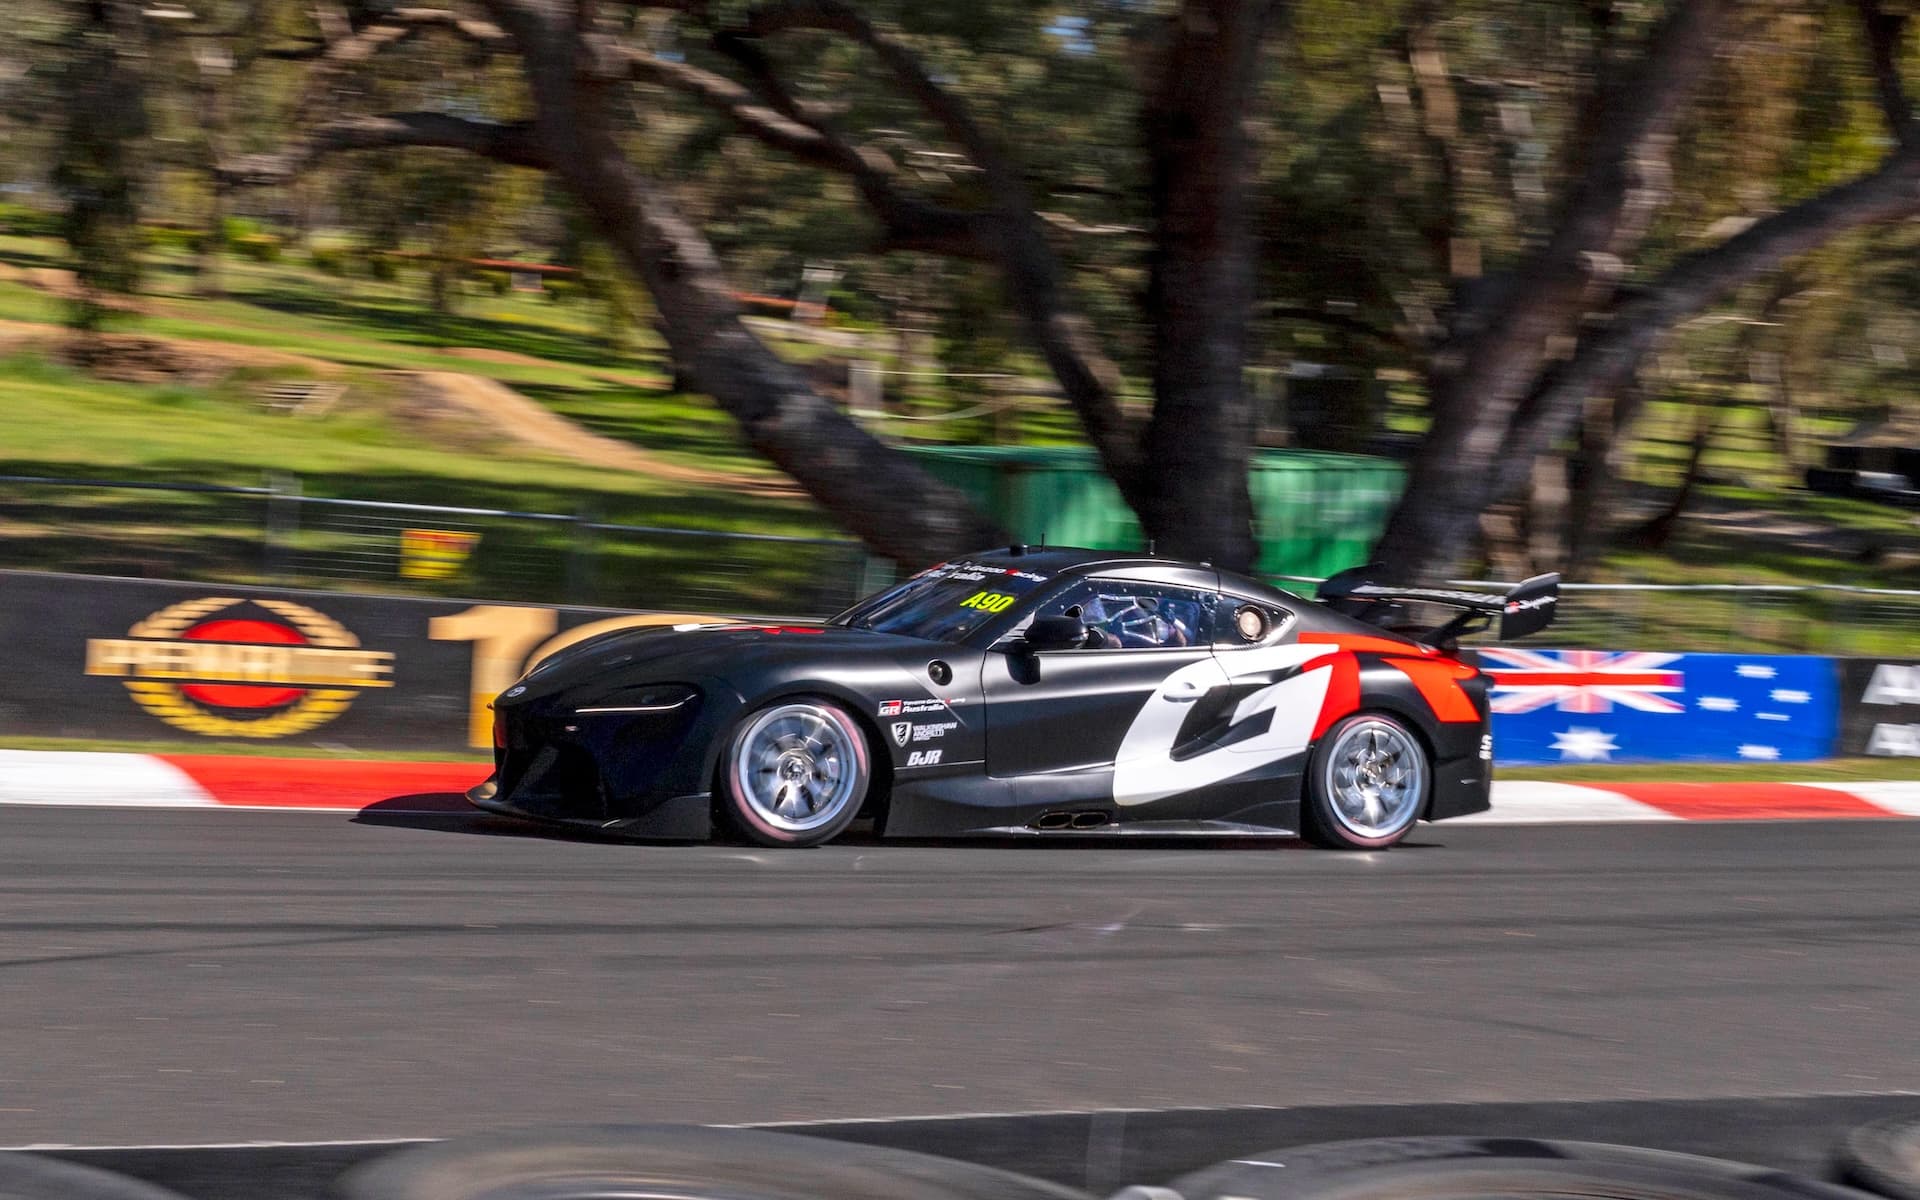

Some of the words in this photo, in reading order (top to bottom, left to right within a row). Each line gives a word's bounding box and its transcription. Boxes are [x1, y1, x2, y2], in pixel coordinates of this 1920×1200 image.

[960, 591, 1015, 613] A90
[879, 705, 900, 716] GR
[902, 704, 945, 713] Australia
[907, 749, 943, 766] BJR
